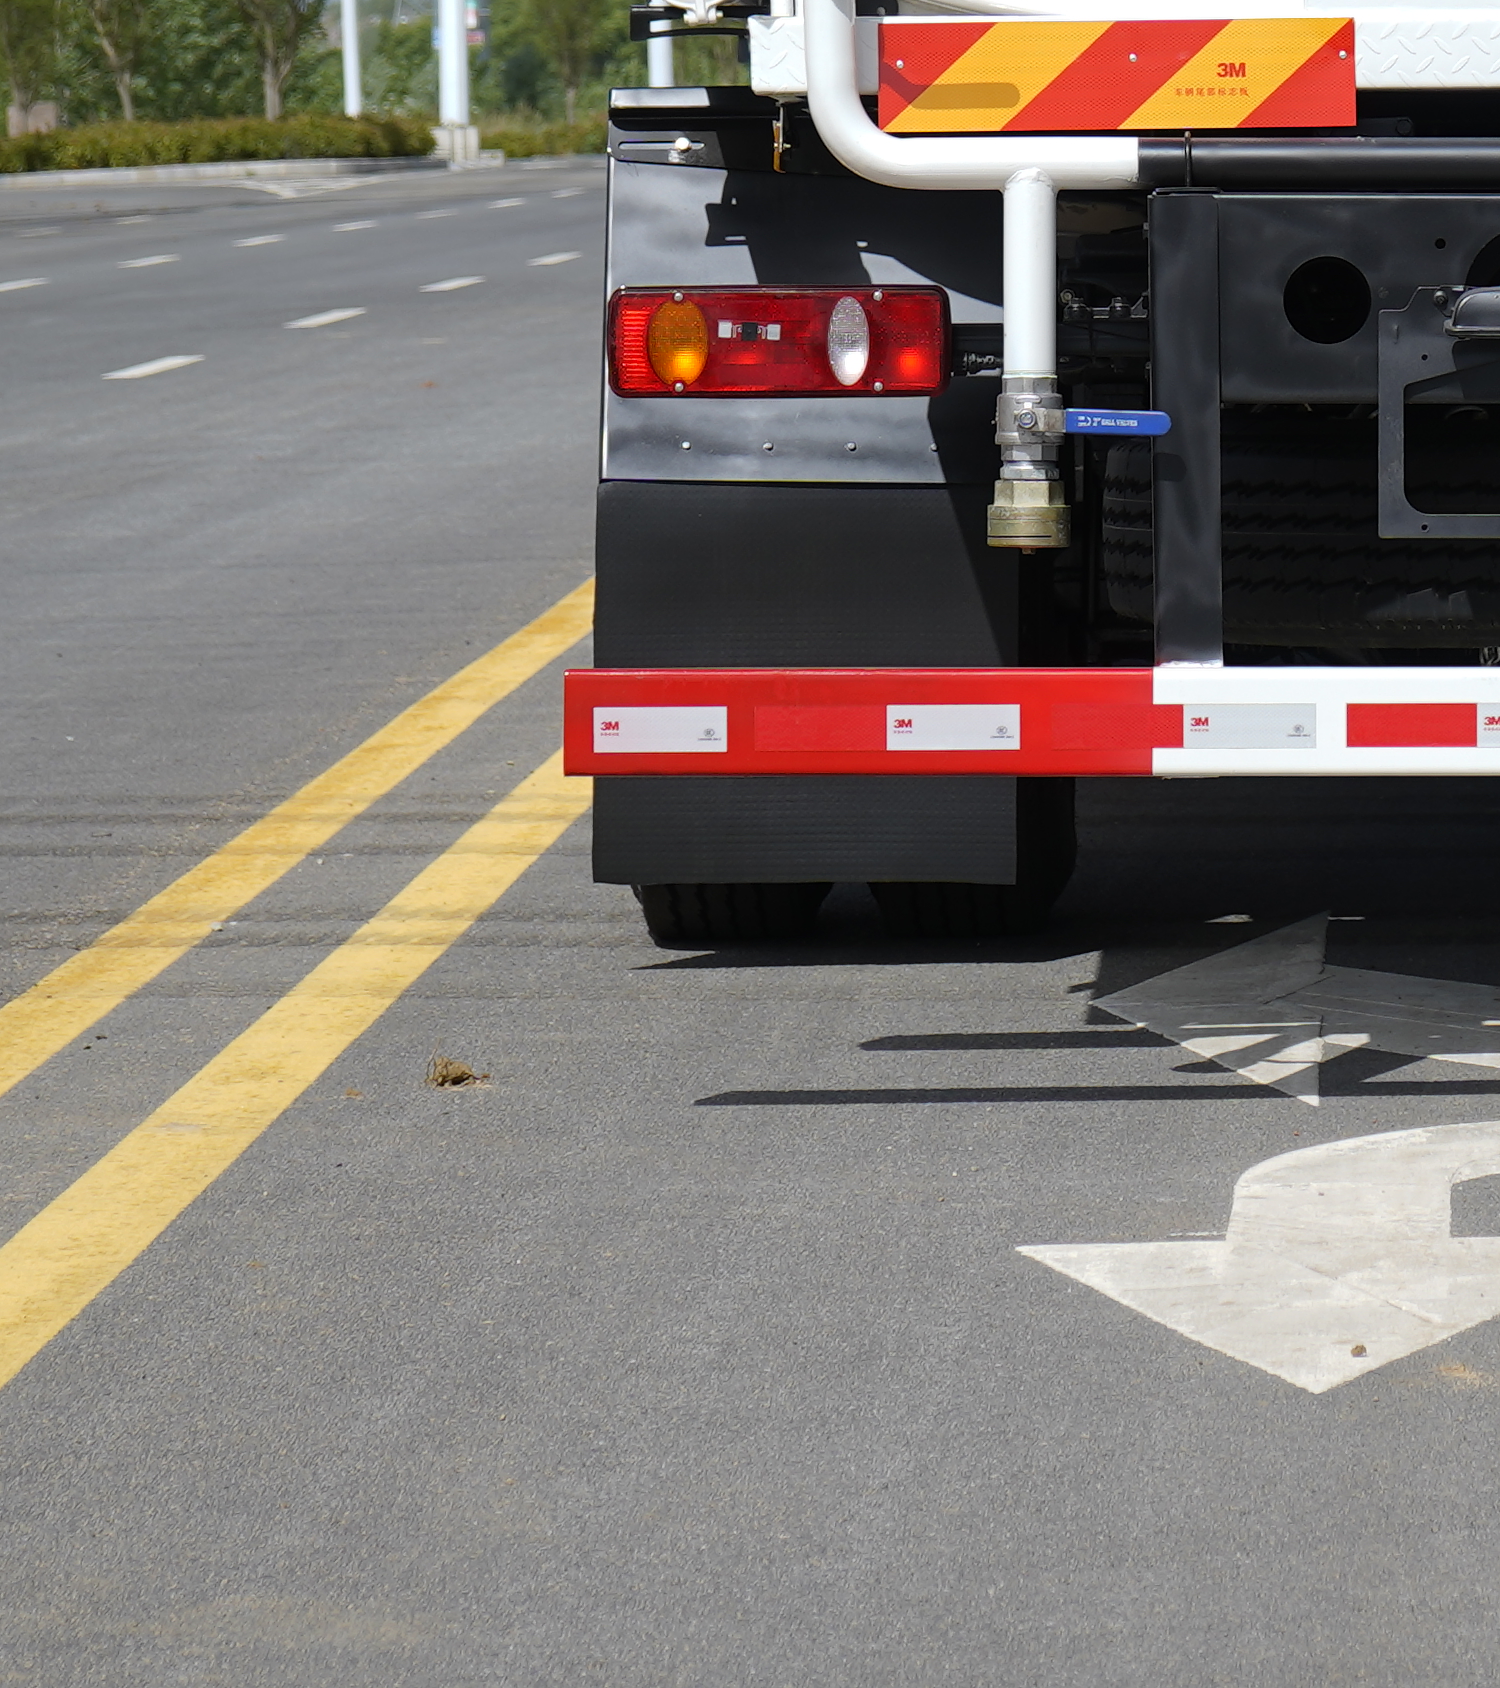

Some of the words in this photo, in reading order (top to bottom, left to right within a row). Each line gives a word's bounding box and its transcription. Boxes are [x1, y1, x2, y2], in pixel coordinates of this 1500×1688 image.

[1217, 62, 1247, 78] 3M
[600, 721, 619, 731] 3M
[893, 719, 912, 729] 3M
[1190, 717, 1209, 727] 3M
